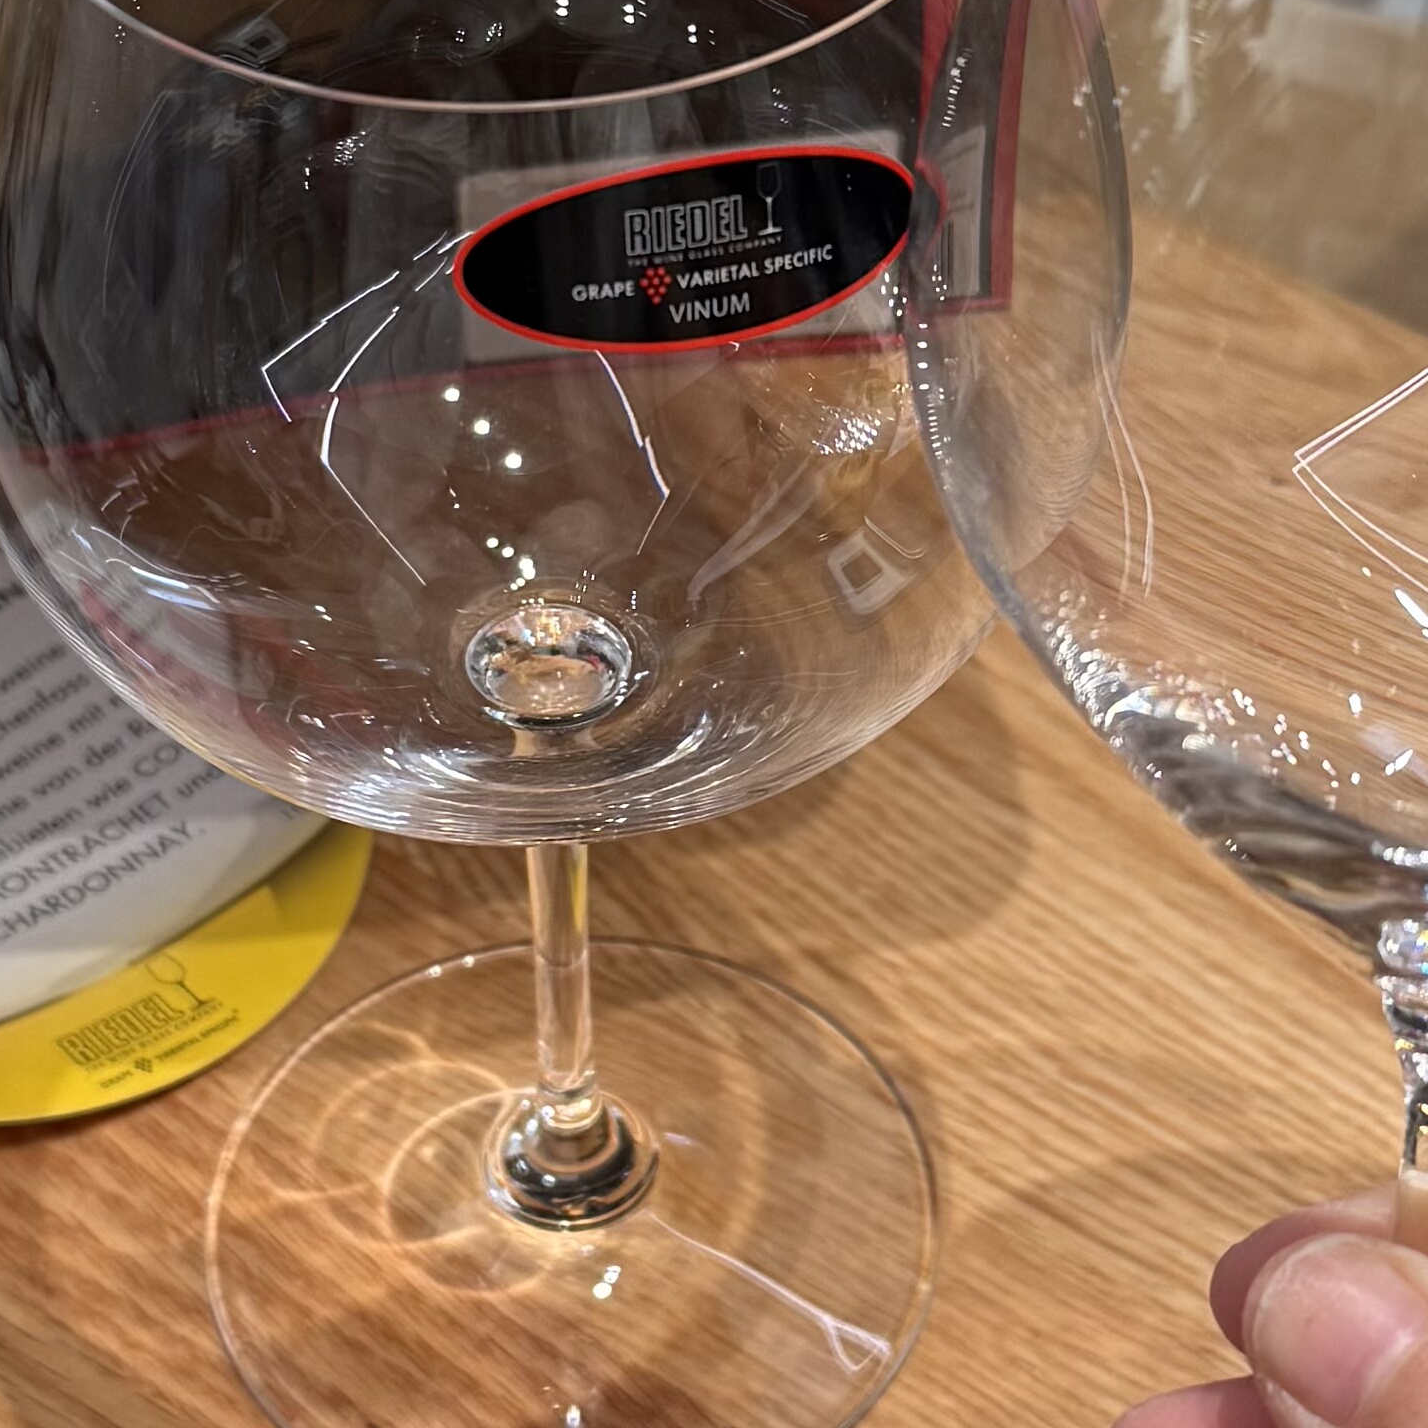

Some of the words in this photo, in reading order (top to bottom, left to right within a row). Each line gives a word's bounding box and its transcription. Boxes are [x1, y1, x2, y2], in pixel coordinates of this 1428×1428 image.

[624, 193, 749, 257] RIEDEL
[571, 279, 636, 302] GRAPE
[676, 261, 760, 290] VARIETAL
[764, 244, 834, 275] SPECIFIC
[669, 292, 751, 324] VINUM
[55, 992, 186, 1068] RIEDEL
